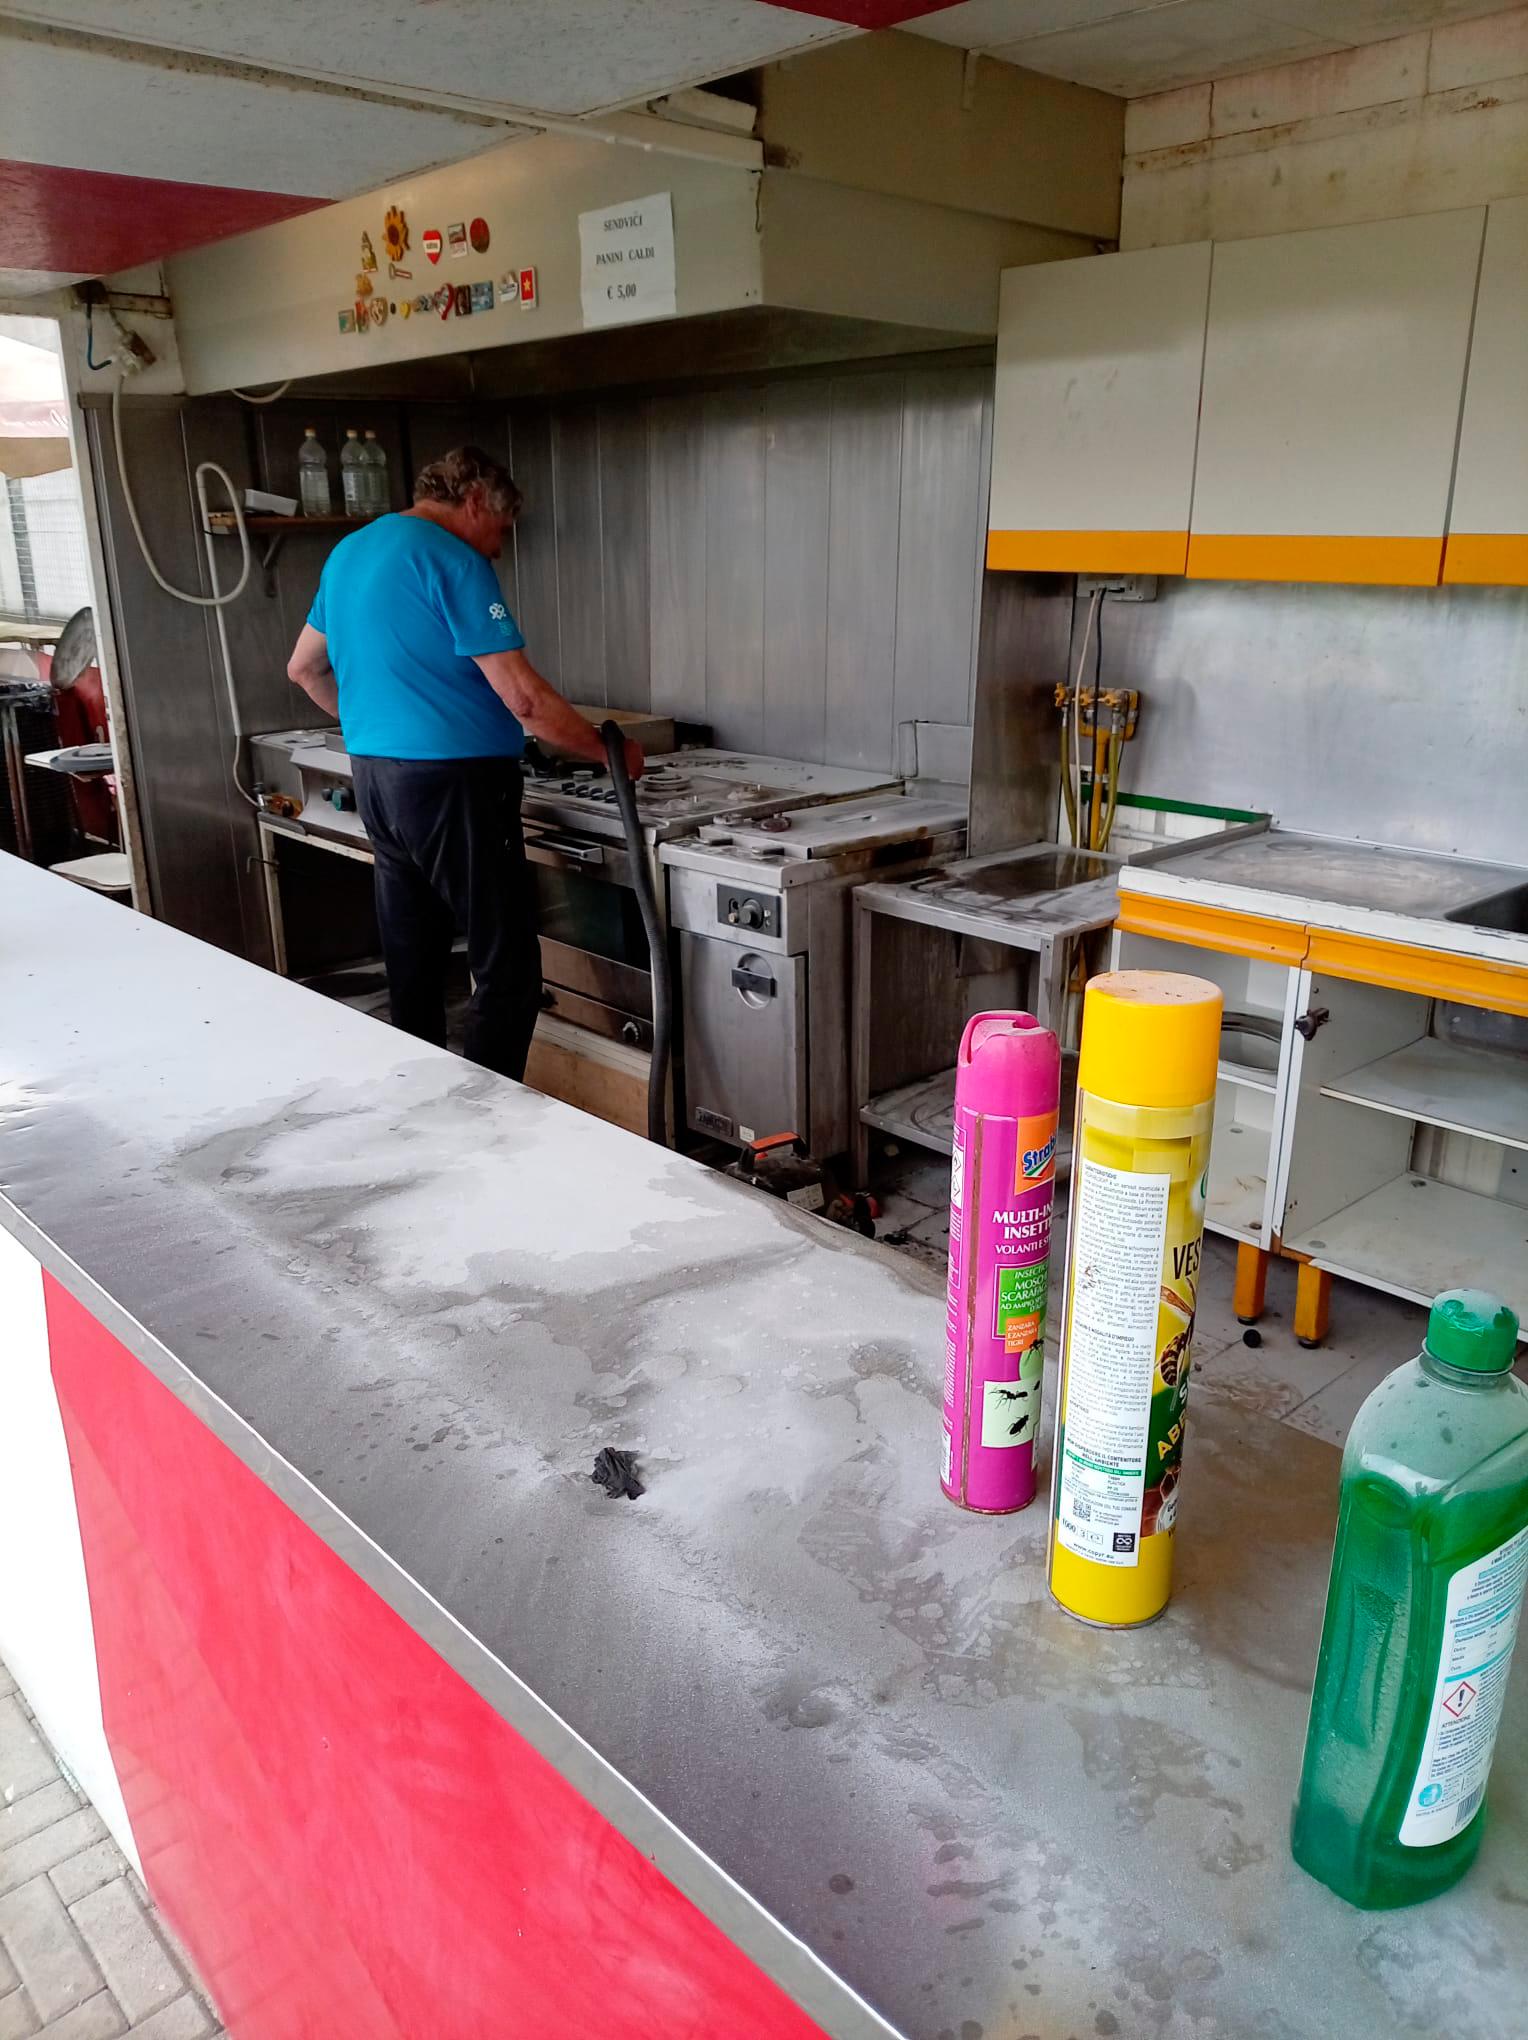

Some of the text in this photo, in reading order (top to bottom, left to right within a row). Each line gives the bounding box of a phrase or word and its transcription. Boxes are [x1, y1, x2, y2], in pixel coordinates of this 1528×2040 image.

[603, 210, 643, 231] SENDVIČI
[596, 246, 655, 265] PANINI CALDI
[607, 283, 637, 300] € 5,00
[995, 1241, 1037, 1255] VOLANTI
